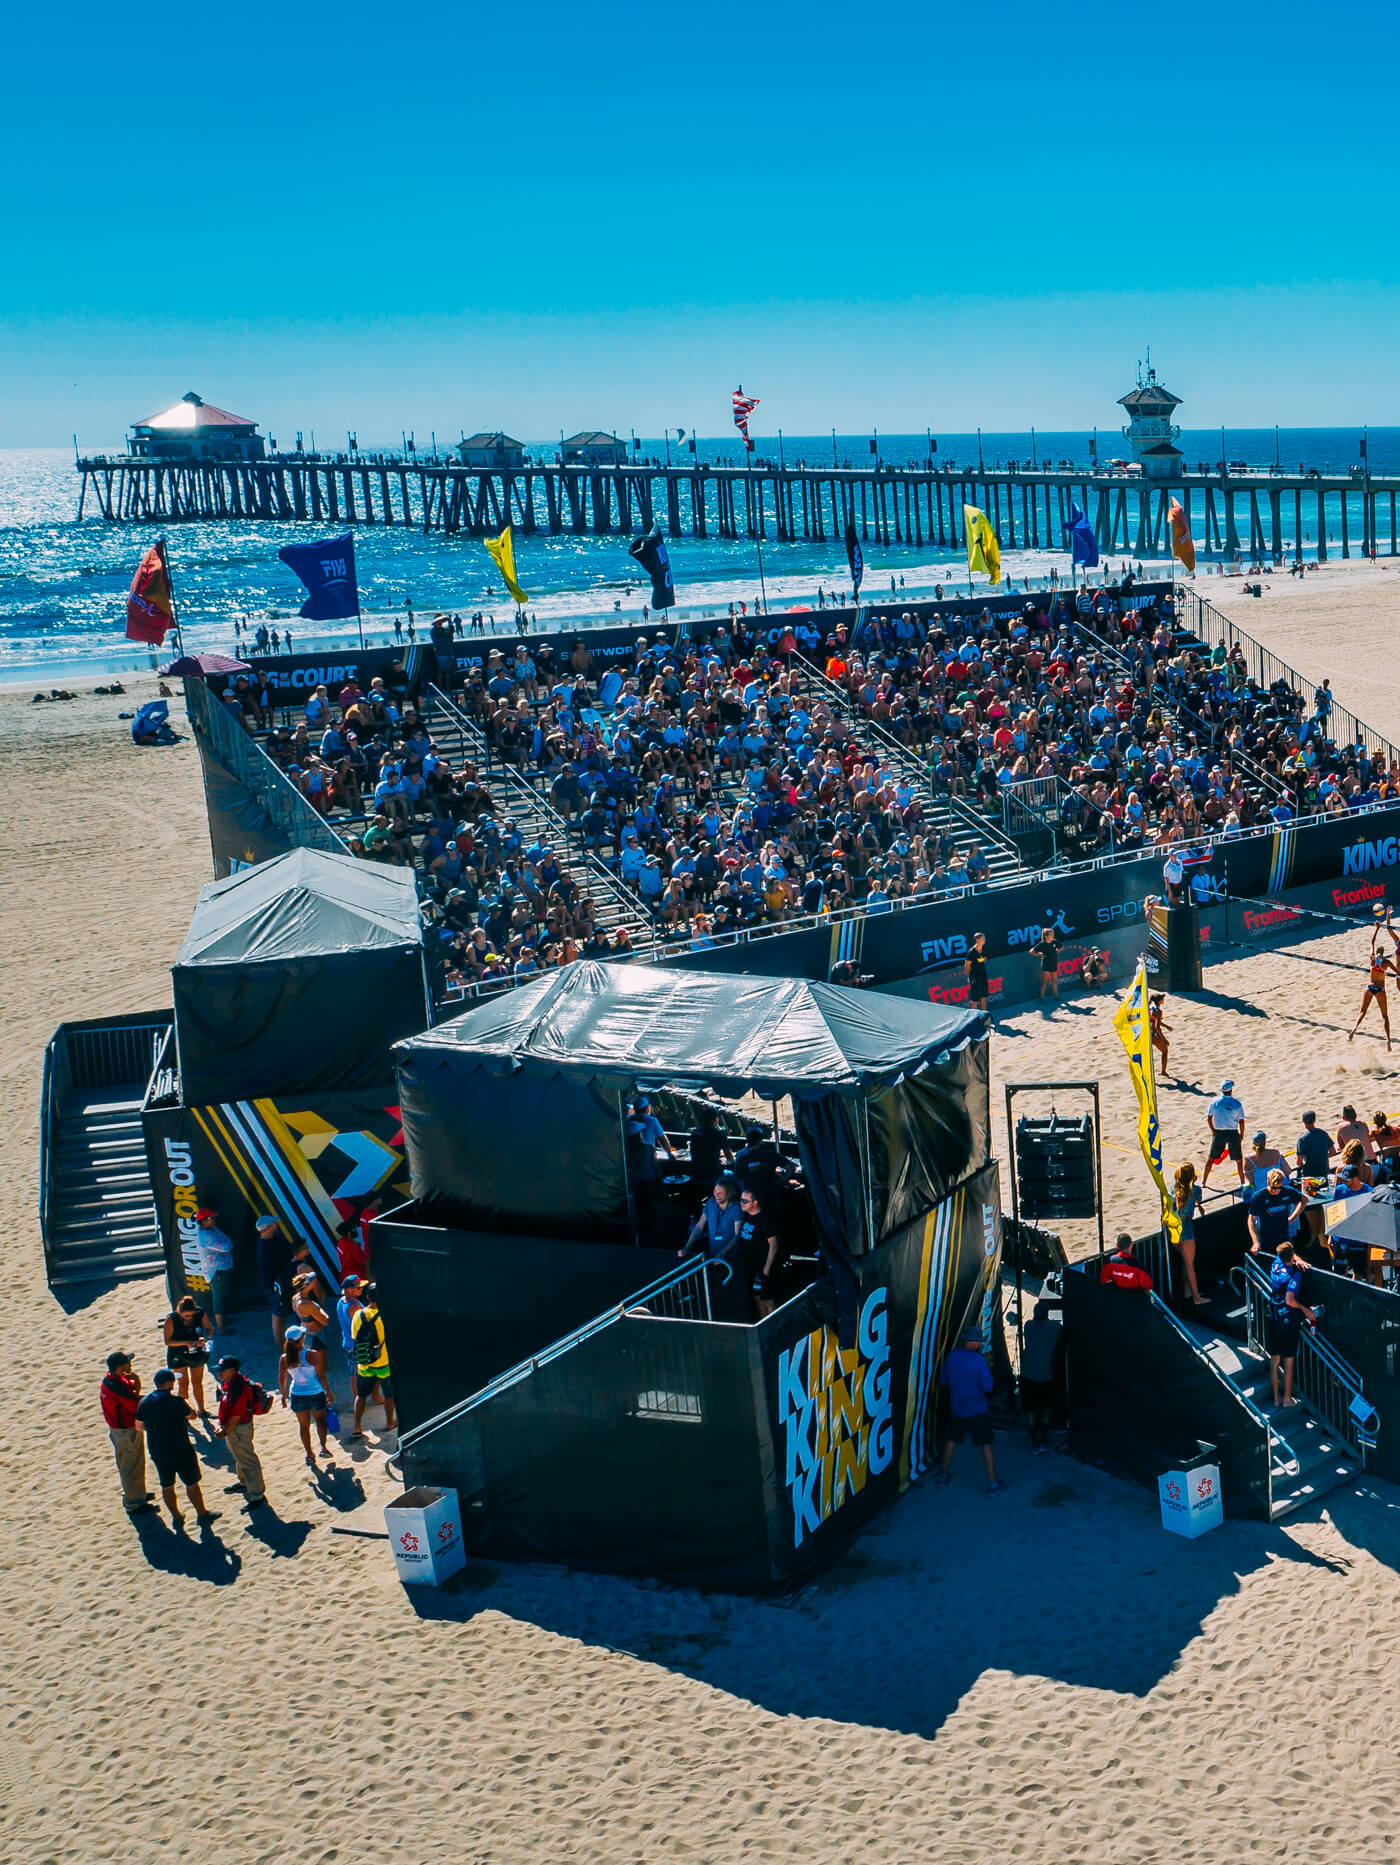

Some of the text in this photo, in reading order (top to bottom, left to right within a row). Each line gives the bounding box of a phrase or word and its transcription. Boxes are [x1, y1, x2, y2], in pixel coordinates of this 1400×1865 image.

[291, 665, 358, 688] COURT
[1341, 836, 1397, 876] KING
[1332, 883, 1386, 908] Frontier
[1244, 904, 1301, 929] Frontier
[921, 934, 968, 962] FIVB
[1007, 924, 1042, 946] avp
[164, 1137, 211, 1292] #KINGOROUT
[779, 1287, 890, 1424] KING
[785, 1346, 893, 1487] KING
[793, 1403, 893, 1549] KING
